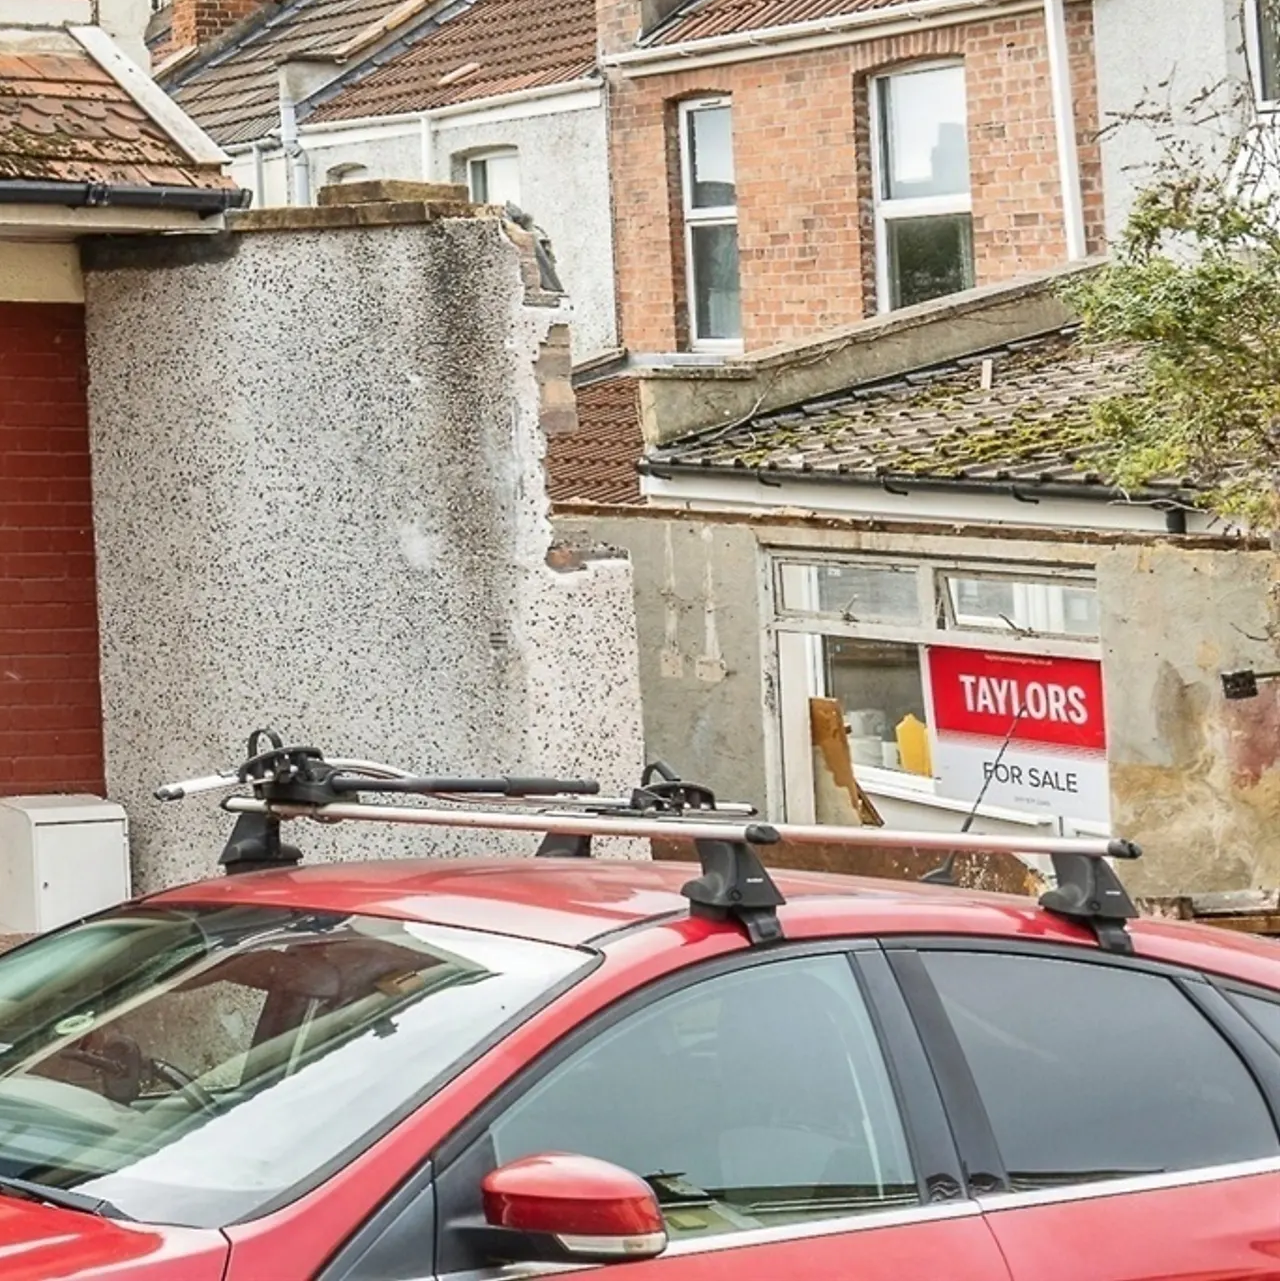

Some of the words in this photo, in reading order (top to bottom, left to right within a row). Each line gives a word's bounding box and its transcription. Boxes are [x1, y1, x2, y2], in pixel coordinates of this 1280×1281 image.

[958, 674, 1088, 725] TAYLORS
[983, 762, 1022, 785] FOR
[1029, 768, 1078, 793] SALE
